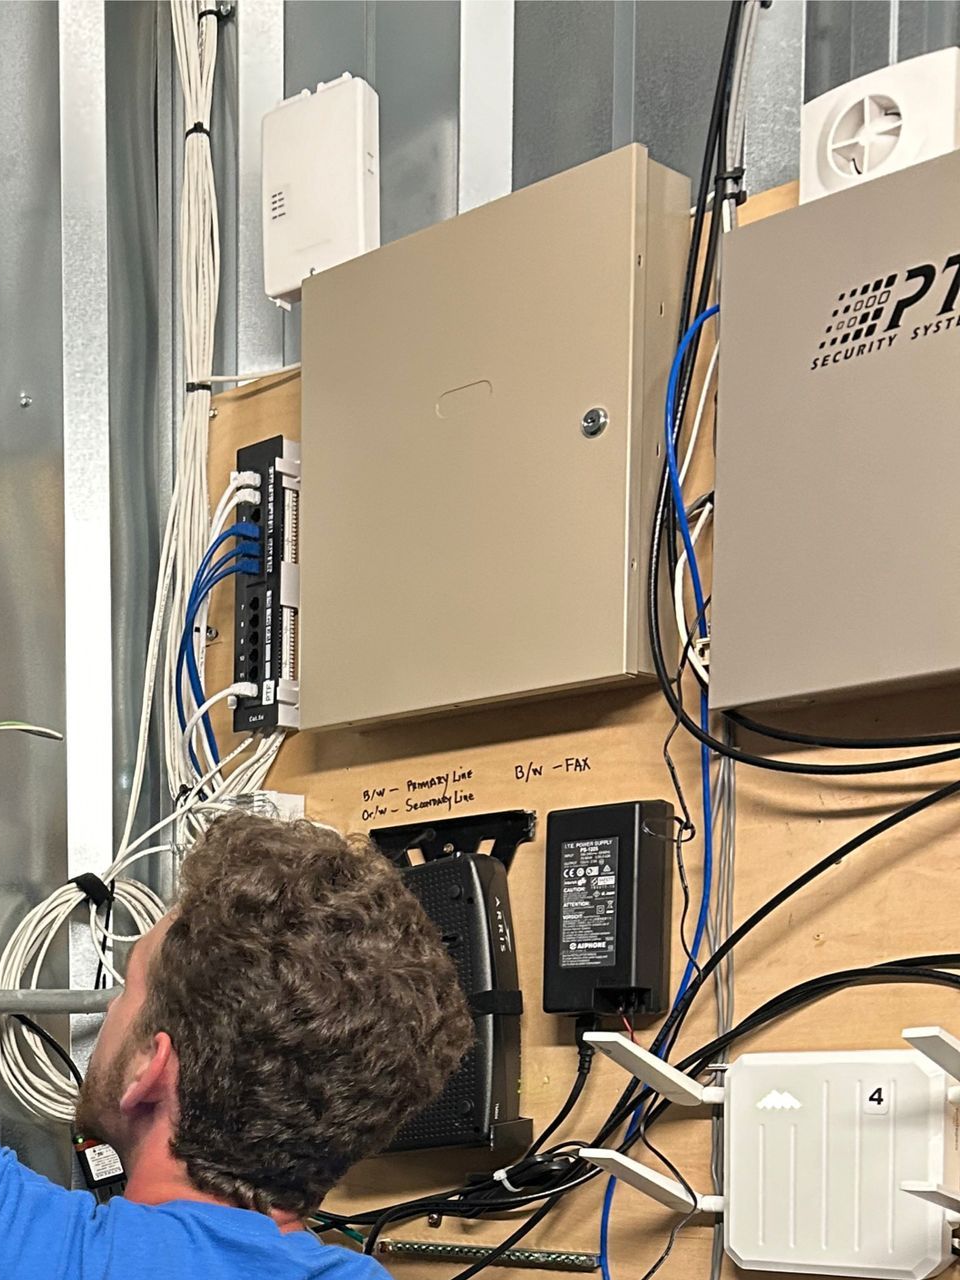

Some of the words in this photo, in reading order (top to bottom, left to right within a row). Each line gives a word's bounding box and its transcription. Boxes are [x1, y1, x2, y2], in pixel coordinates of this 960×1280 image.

[810, 334, 897, 370] SECURITY
[565, 757, 591, 772] FAX
[494, 896, 507, 952] ARRIS
[869, 1087, 884, 1105] 4
